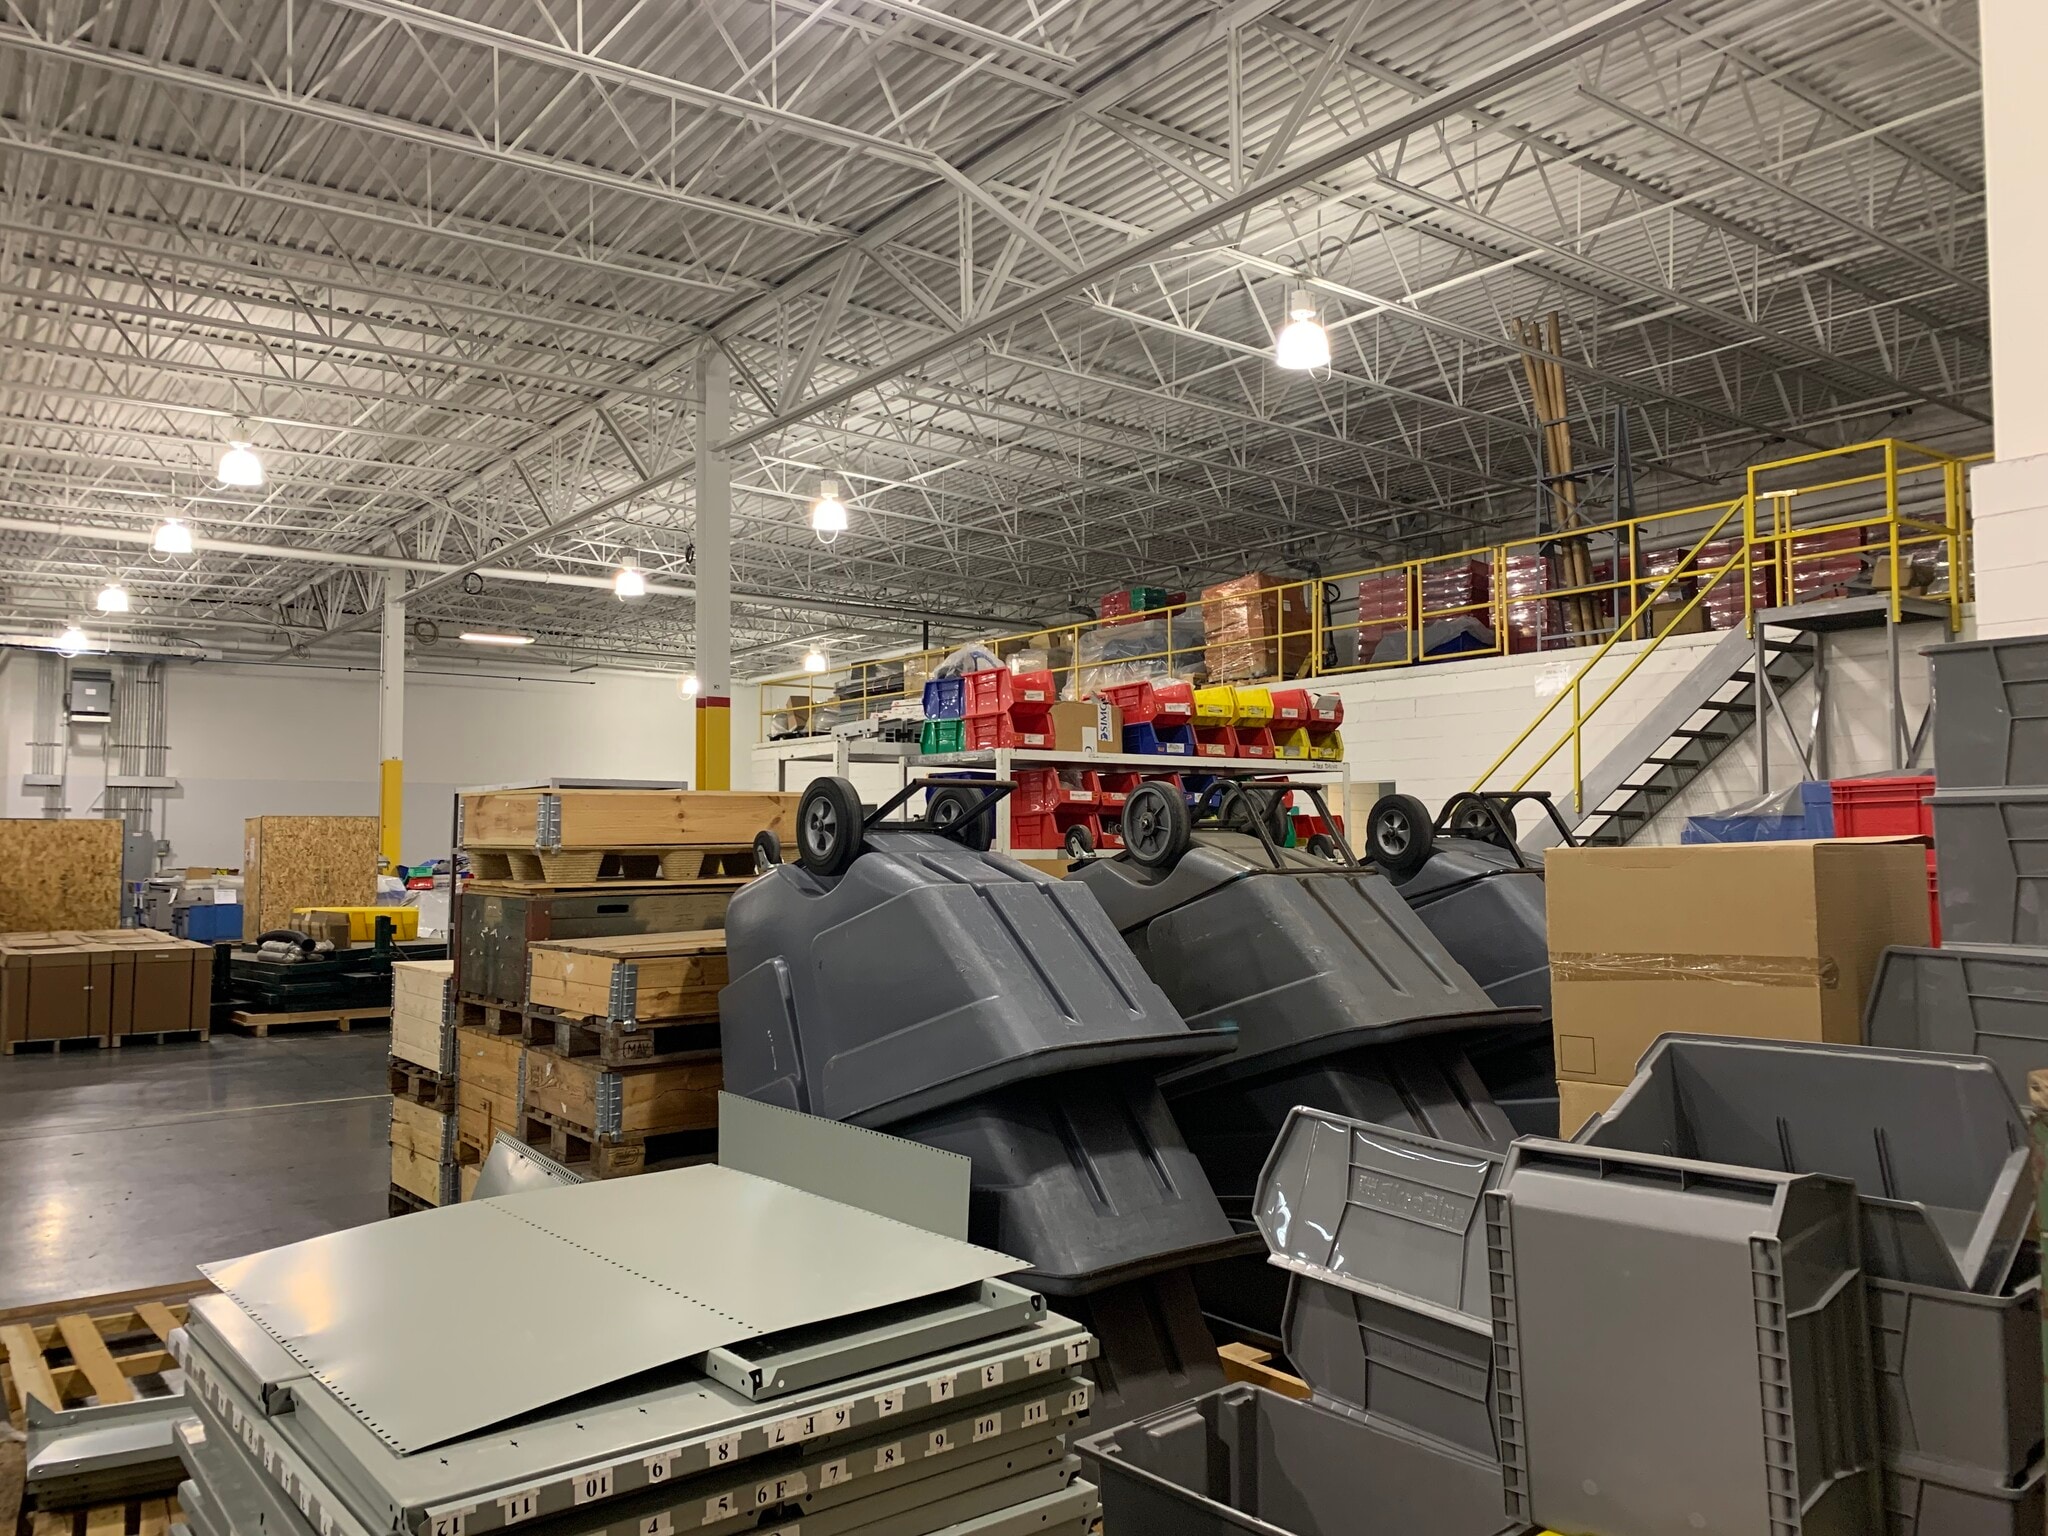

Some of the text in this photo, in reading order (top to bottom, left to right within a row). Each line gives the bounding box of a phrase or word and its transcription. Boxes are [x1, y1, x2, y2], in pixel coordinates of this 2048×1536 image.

[986, 1365, 995, 1382] 3
[940, 1381, 949, 1396] 4
[884, 1398, 893, 1411] 5
[835, 1410, 845, 1426] 6
[775, 1428, 785, 1443] 7
[718, 1442, 729, 1461] 8
[648, 1517, 659, 1534] 4
[718, 1496, 728, 1512] 5
[757, 1485, 768, 1504] 6
[829, 1465, 839, 1480] 7
[885, 1448, 894, 1463] 8
[935, 1433, 944, 1448] 9
[978, 1419, 994, 1435] 10
[1028, 1405, 1041, 1420] 11
[1072, 1391, 1085, 1407] 12
[586, 1476, 608, 1498] 10
[511, 1497, 532, 1519] 11
[437, 1516, 460, 1536] 12
